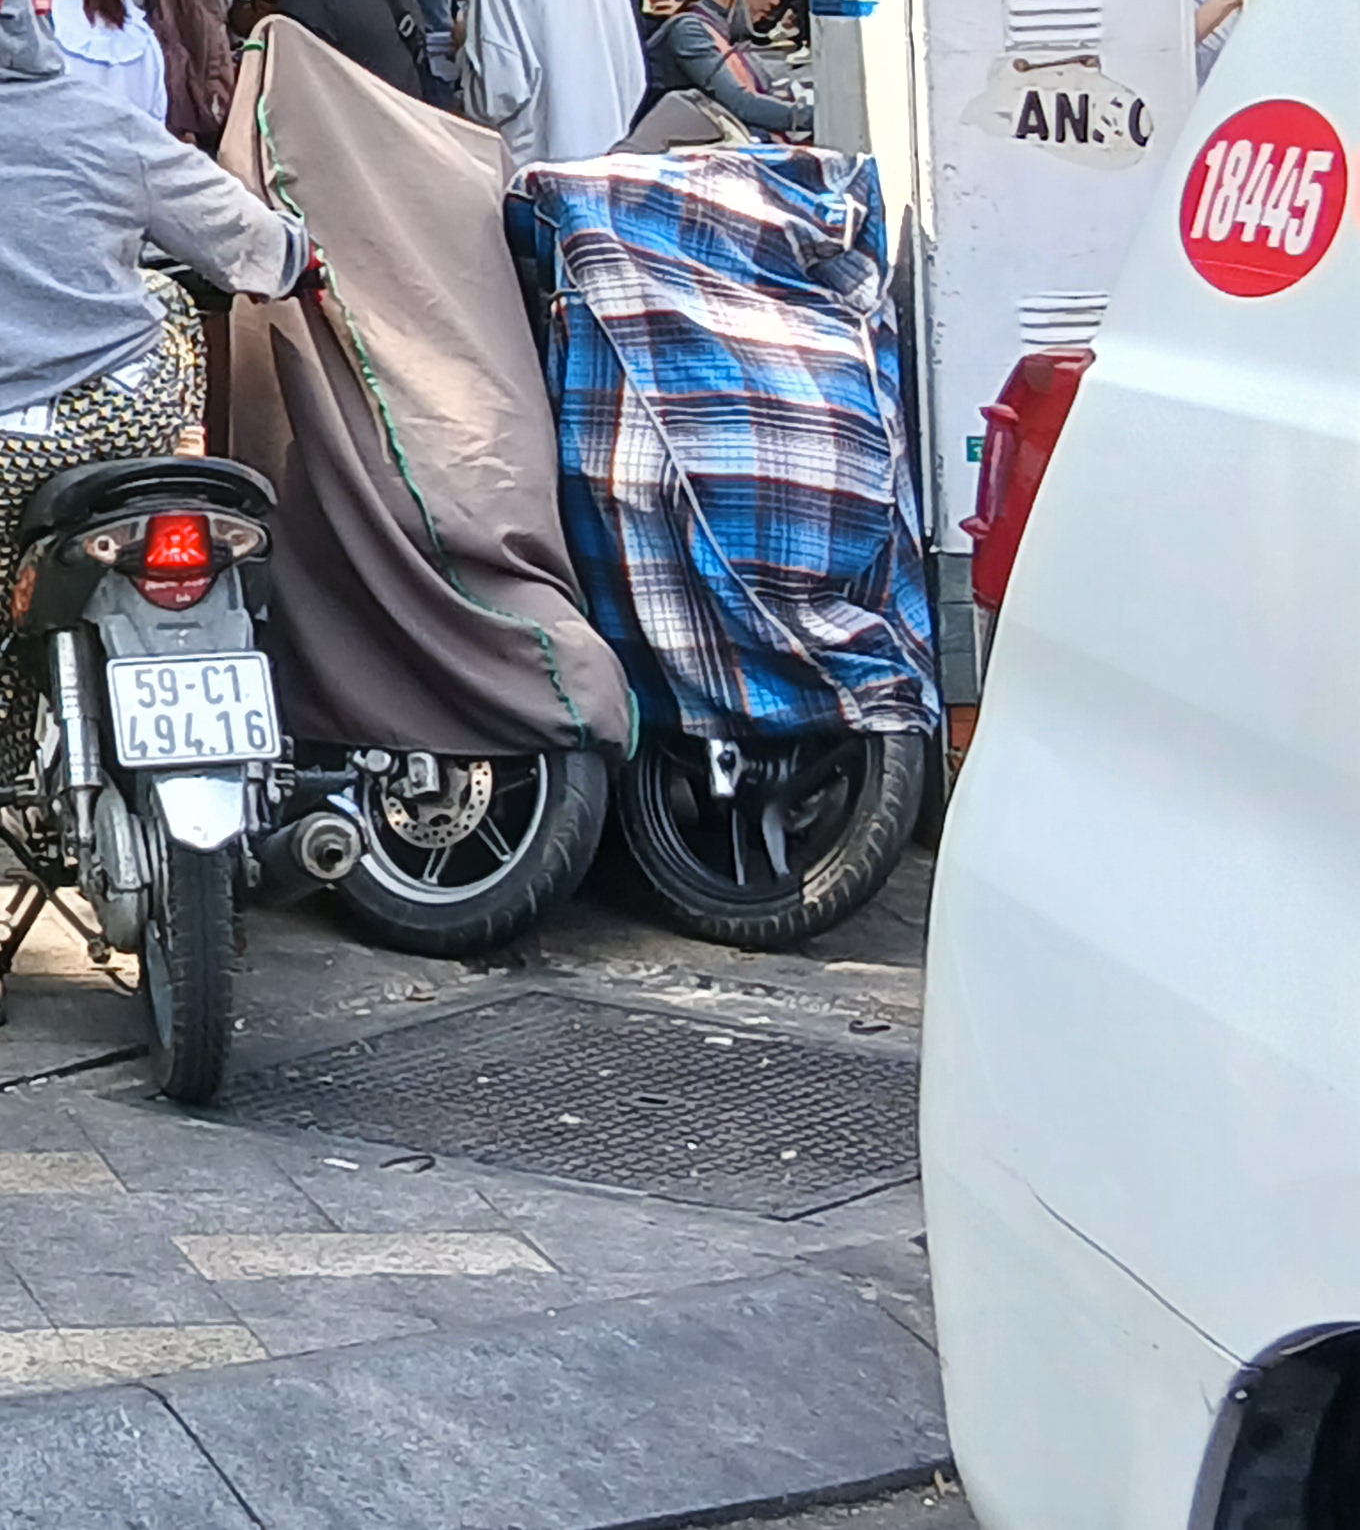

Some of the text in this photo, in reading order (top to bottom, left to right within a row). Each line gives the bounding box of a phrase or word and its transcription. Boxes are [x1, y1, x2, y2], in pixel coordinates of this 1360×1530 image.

[1190, 140, 1335, 256] 18445
[134, 664, 242, 709] 59-C1
[130, 709, 268, 759] 494.16
